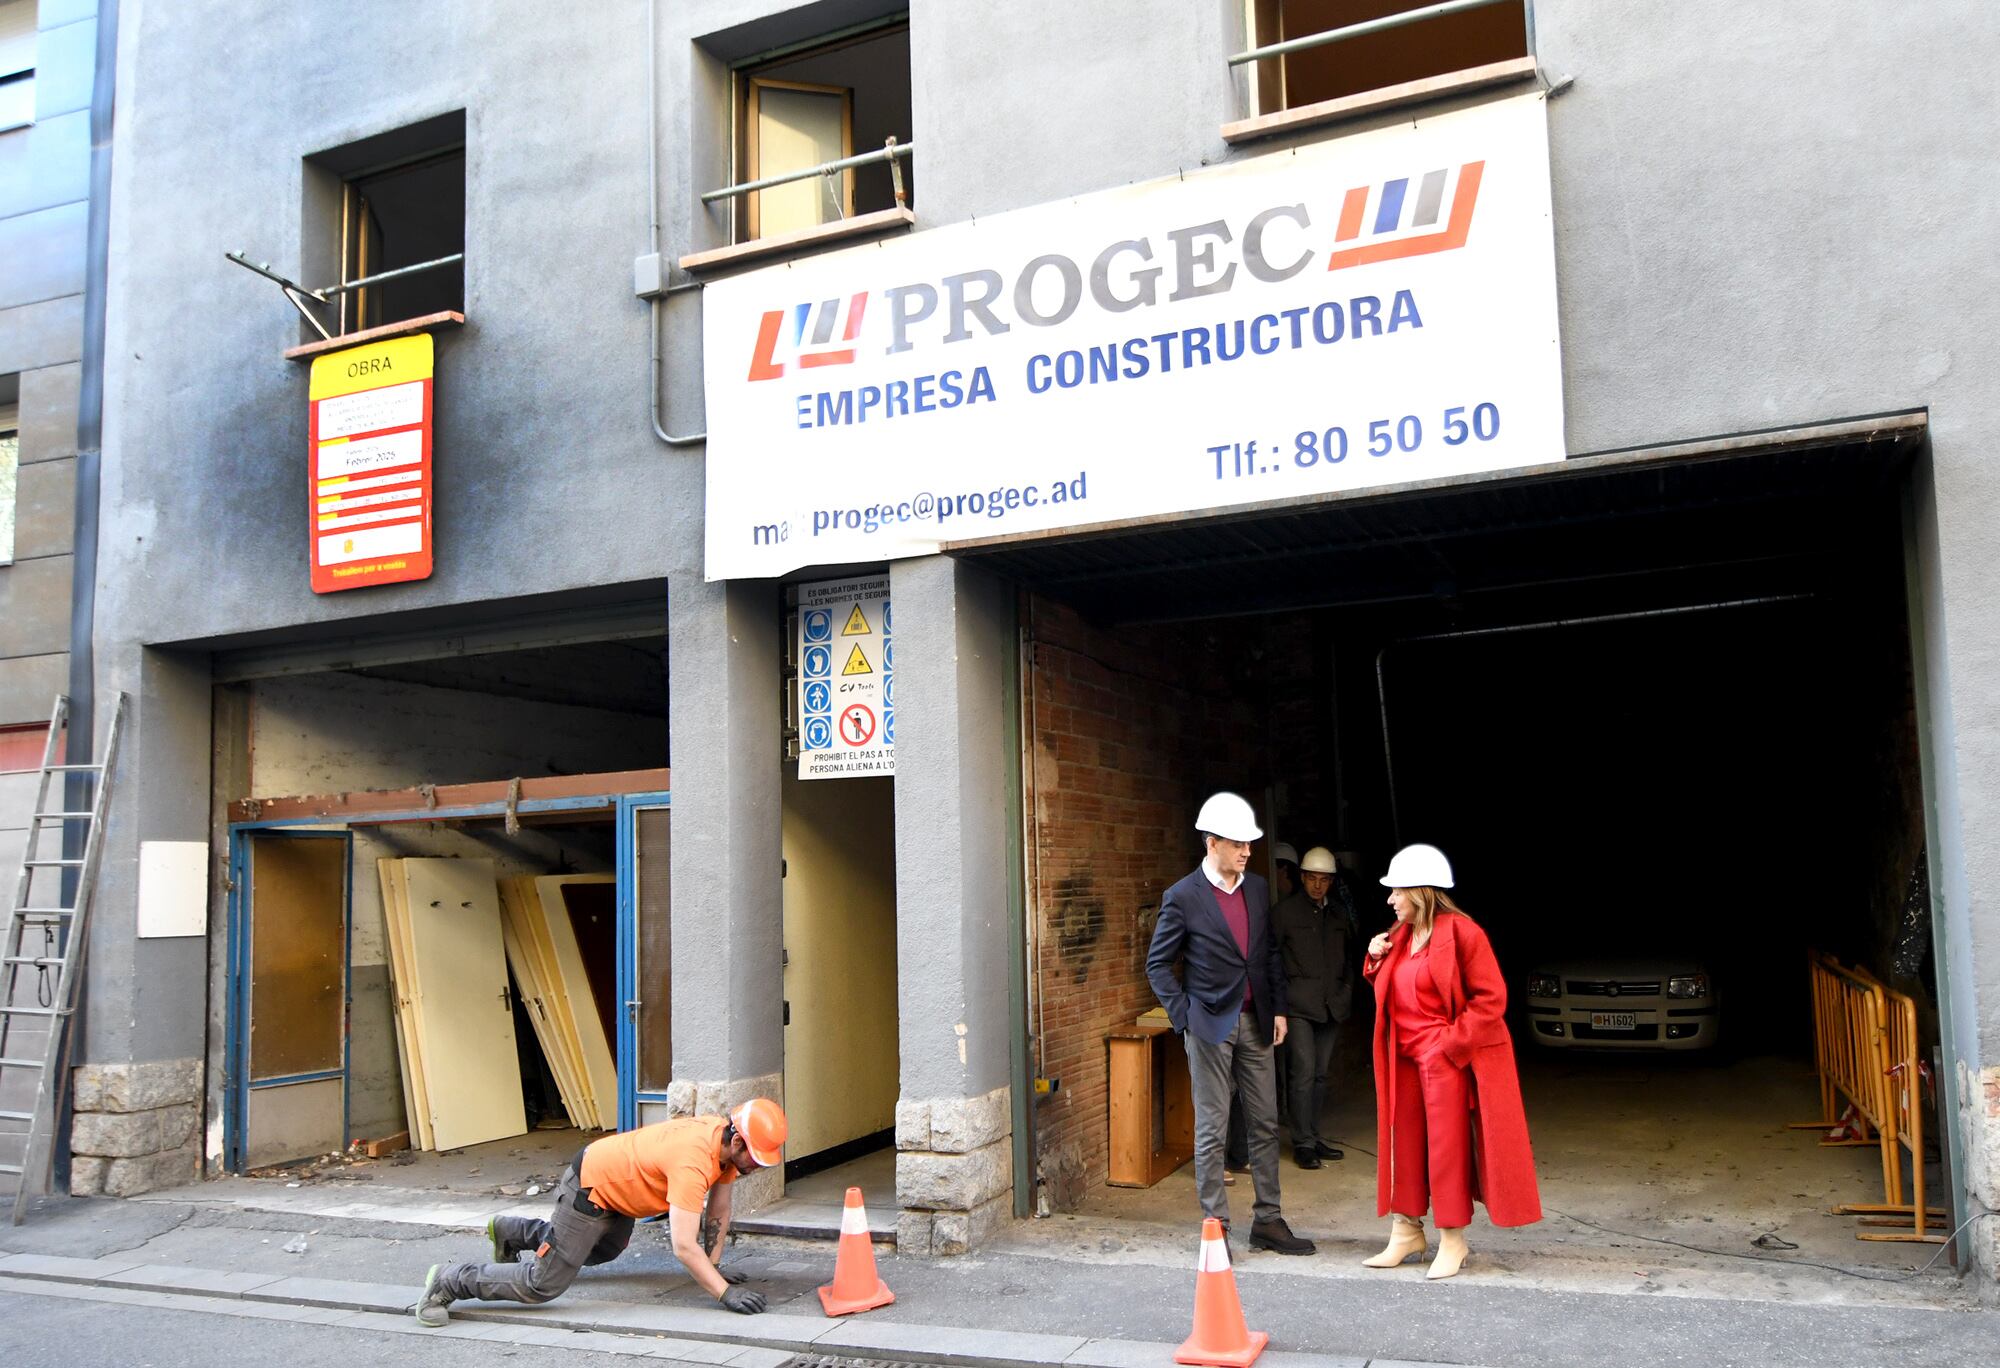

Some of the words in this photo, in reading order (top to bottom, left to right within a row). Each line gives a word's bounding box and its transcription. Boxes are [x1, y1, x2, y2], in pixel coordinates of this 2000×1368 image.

[885, 203, 1315, 355] PROGEC
[798, 366, 996, 429] EMPRESA
[1026, 289, 1423, 394] CONSTRUCTORA
[347, 356, 393, 378] OBRA
[1207, 438, 1281, 481] Tlf.:
[1294, 427, 1348, 468] 80
[1368, 415, 1422, 457] 50
[1442, 402, 1500, 446] 50
[813, 471, 1087, 536] progec@progec.ad
[818, 585, 858, 596] OBLIGATORI
[859, 581, 885, 591] SEGUIR
[810, 598, 824, 606] LES
[825, 594, 853, 605] NORMES
[854, 593, 863, 601] DE
[839, 683, 855, 692] CV
[814, 752, 847, 762] PROHIBIT
[849, 751, 858, 760] EL
[860, 751, 876, 760] PAS
[877, 750, 883, 758] A
[809, 764, 844, 774] PERSONA
[846, 762, 873, 771] ALIENA
[875, 761, 881, 770] A
[1602, 1015, 1634, 1026] H1602
